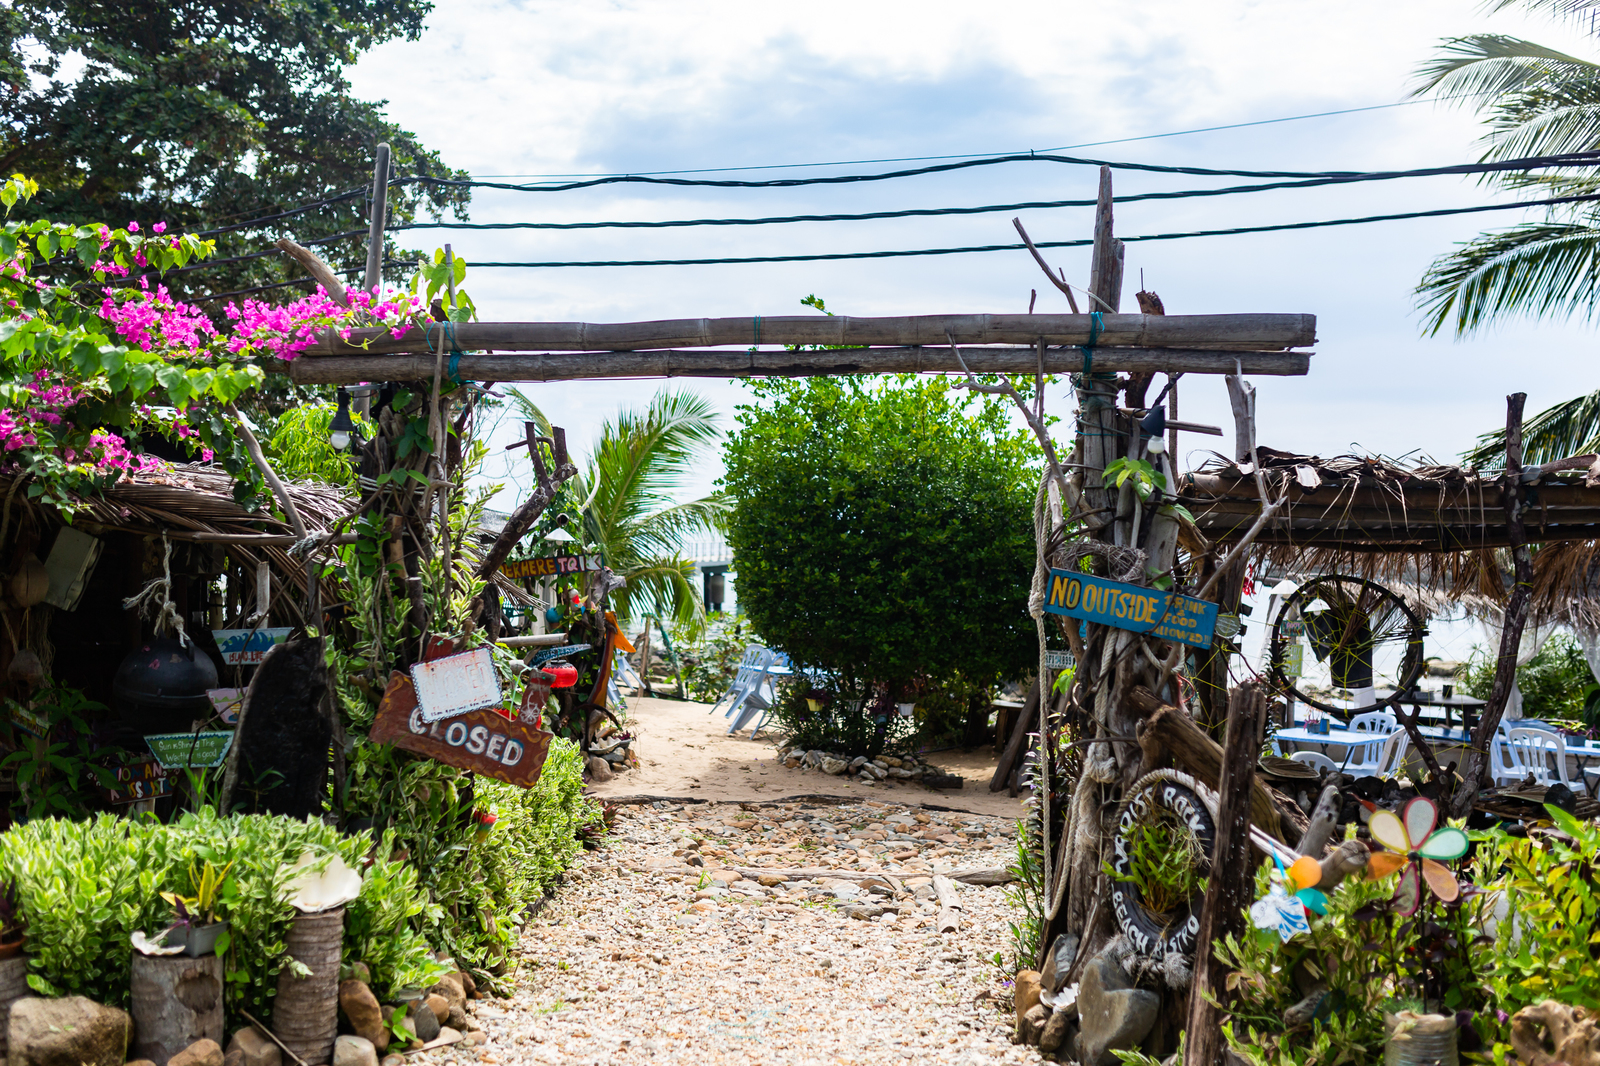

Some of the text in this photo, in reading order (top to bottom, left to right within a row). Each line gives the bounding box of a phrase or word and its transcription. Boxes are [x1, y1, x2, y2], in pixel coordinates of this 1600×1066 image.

[1048, 575, 1159, 623] NO OUTSIDE
[1164, 595, 1207, 614] DRINK
[1163, 612, 1197, 628] FOOD
[158, 740, 171, 751] Sun
[408, 706, 524, 766] CLOSED
[201, 748, 218, 761] good
[143, 776, 178, 796] BISTRO
[1163, 786, 1206, 831] ROCK
[1112, 890, 1150, 954] BEACH
